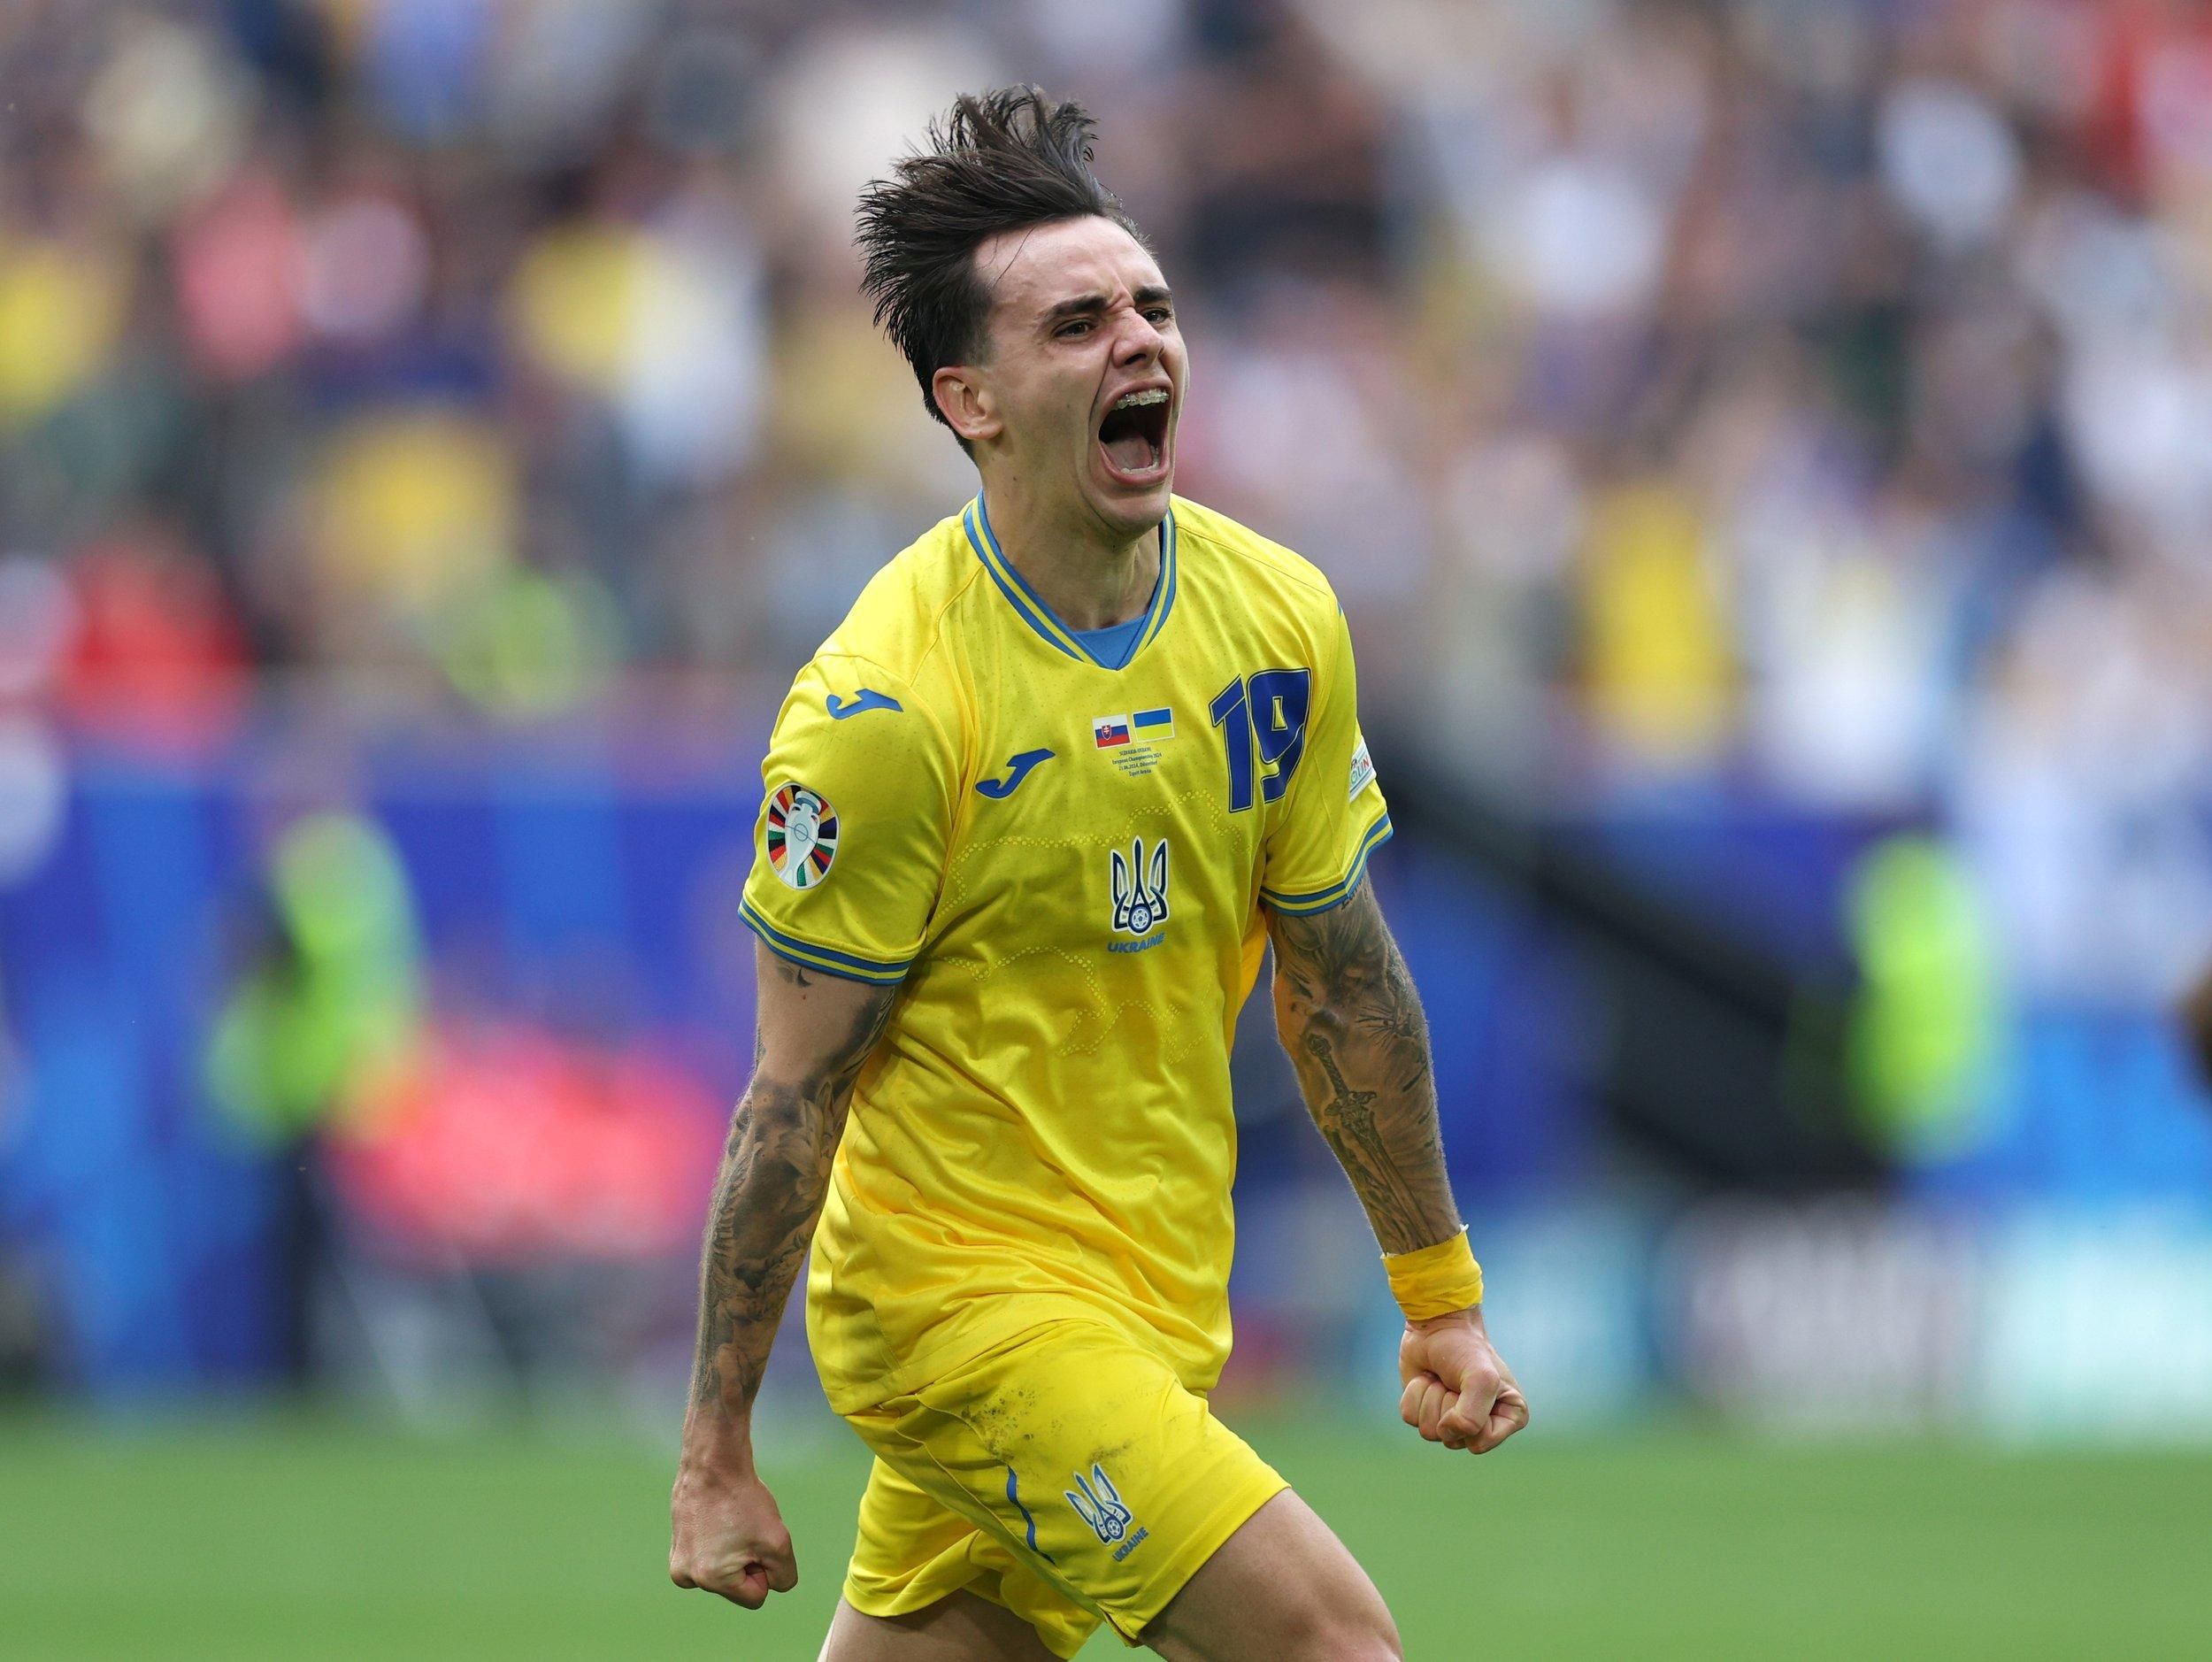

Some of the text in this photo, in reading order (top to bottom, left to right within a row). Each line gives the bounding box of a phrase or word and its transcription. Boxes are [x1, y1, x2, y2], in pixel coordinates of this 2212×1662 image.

[1208, 667, 1312, 813] 19
[1107, 932, 1165, 953] UKRAINE
[1112, 1527, 1148, 1562] UKRAINE
